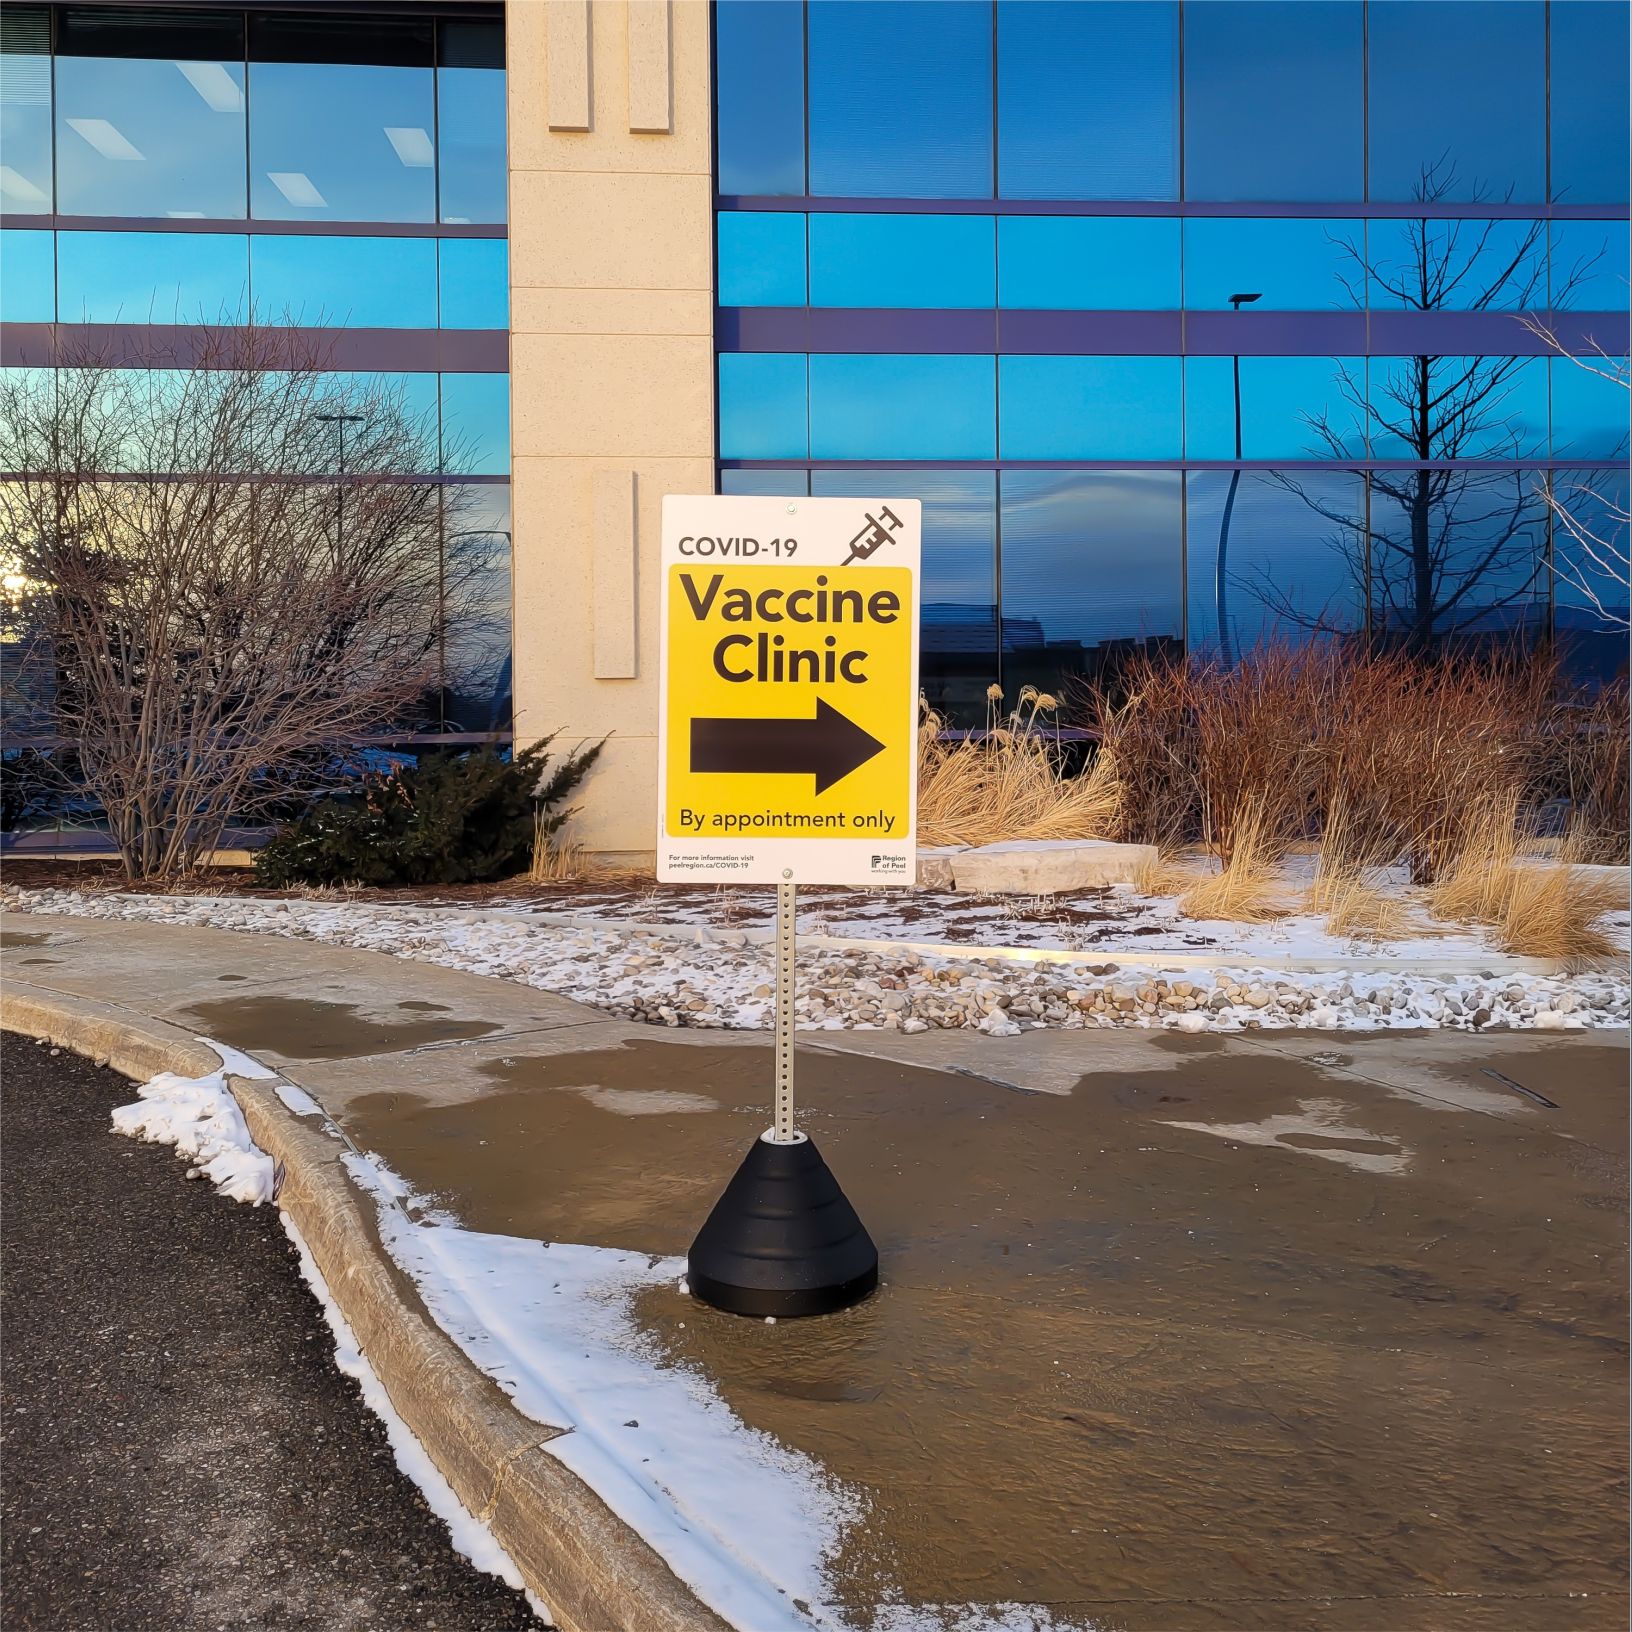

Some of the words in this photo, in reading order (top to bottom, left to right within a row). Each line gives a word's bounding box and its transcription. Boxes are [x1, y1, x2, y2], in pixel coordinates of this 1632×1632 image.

[678, 536, 798, 558] COVID-19
[678, 573, 901, 624] Vaccine
[713, 632, 869, 684] Clinic
[680, 809, 705, 831] By
[712, 809, 846, 831] appointment
[852, 809, 896, 833] only
[882, 854, 906, 862] Region
